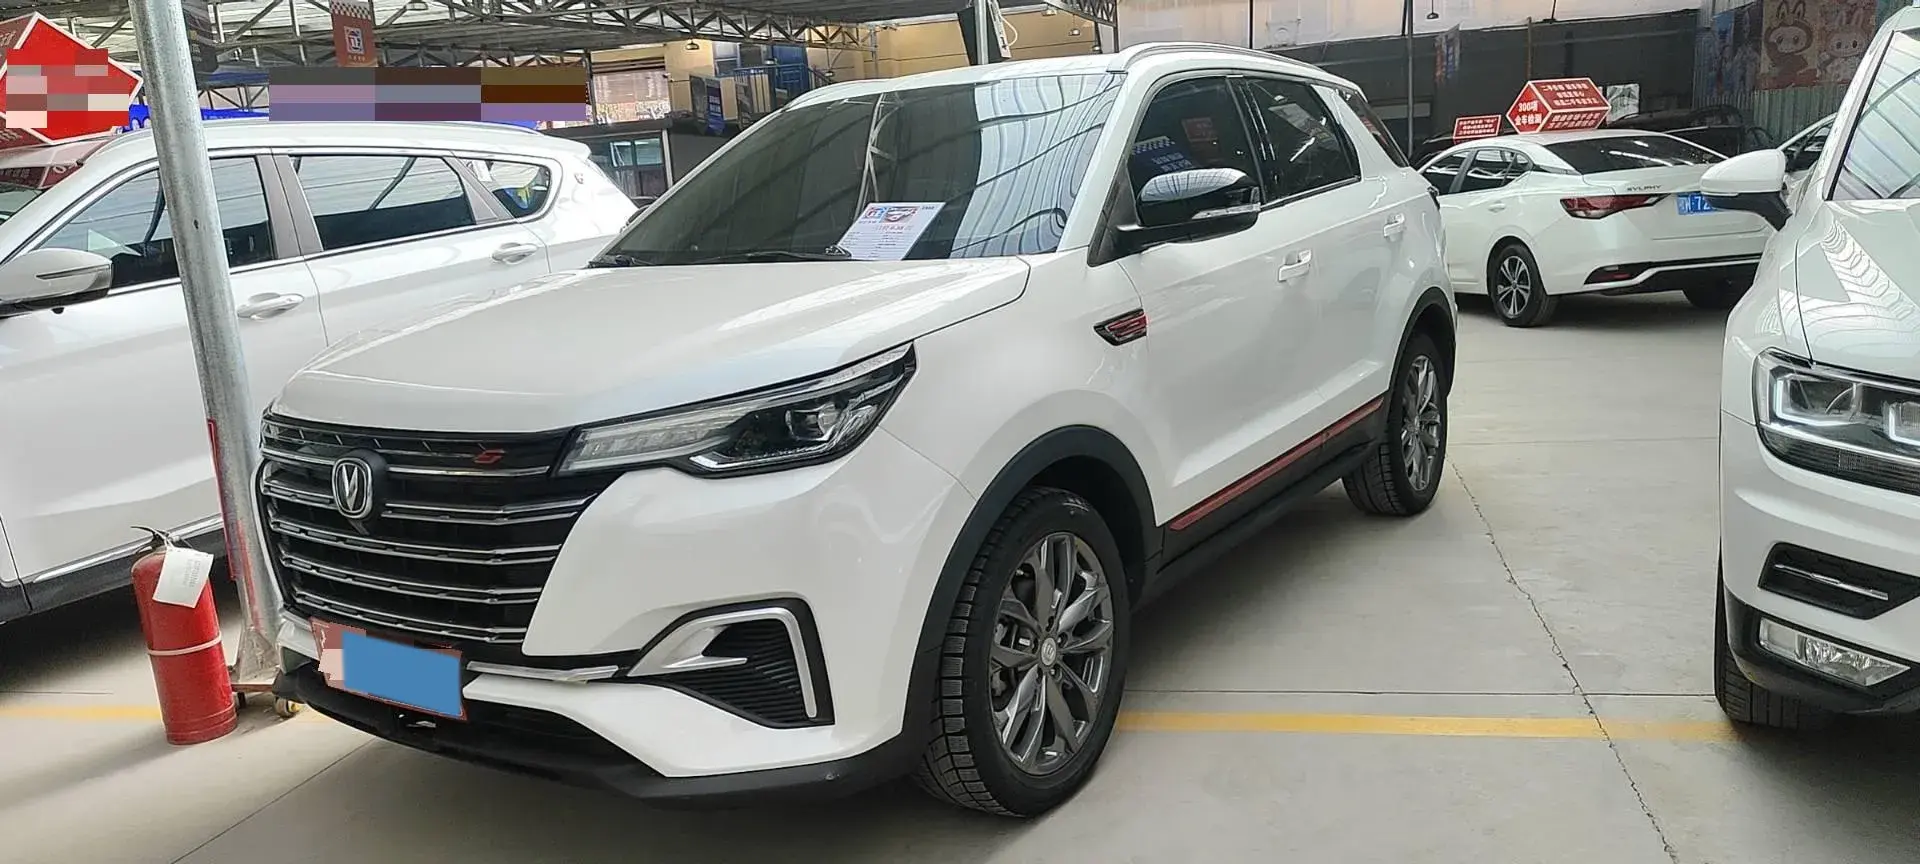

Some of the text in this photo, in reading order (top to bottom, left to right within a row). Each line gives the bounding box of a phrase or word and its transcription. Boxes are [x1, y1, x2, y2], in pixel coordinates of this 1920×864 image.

[1518, 100, 1538, 113] 300项
[1514, 113, 1542, 126] 全车检测
[1627, 184, 1662, 192] SYLPHY
